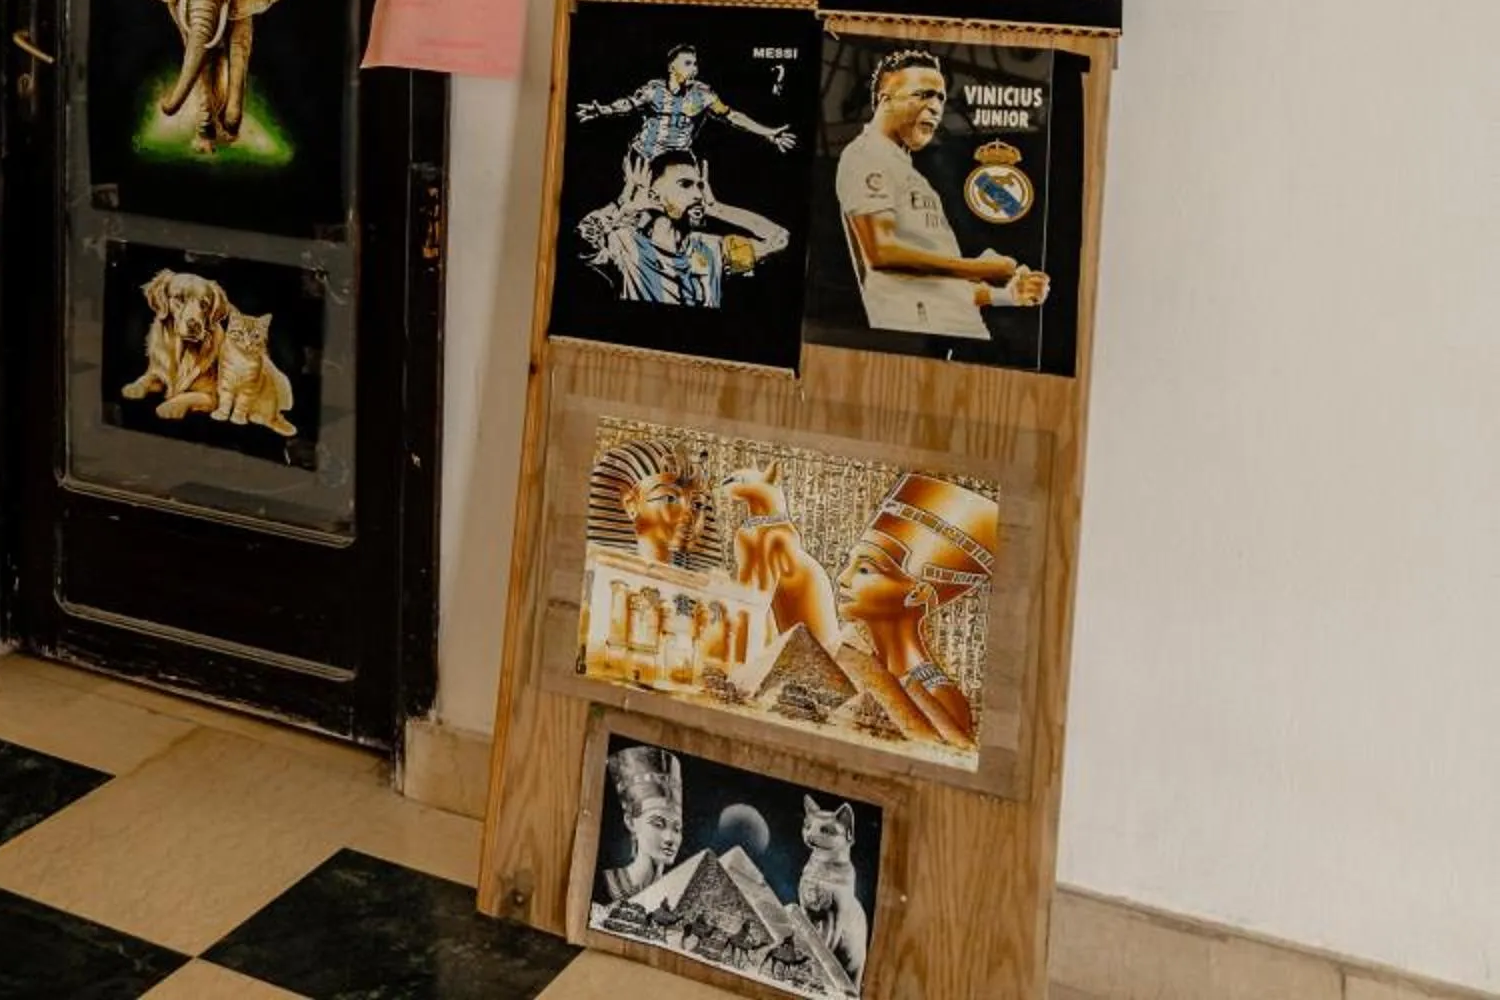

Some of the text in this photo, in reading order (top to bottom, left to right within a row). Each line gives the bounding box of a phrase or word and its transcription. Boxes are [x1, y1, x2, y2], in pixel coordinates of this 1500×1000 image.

[753, 47, 798, 60] MESSI
[964, 85, 1043, 107] VINICIUS
[972, 108, 1029, 128] JUNIOR
